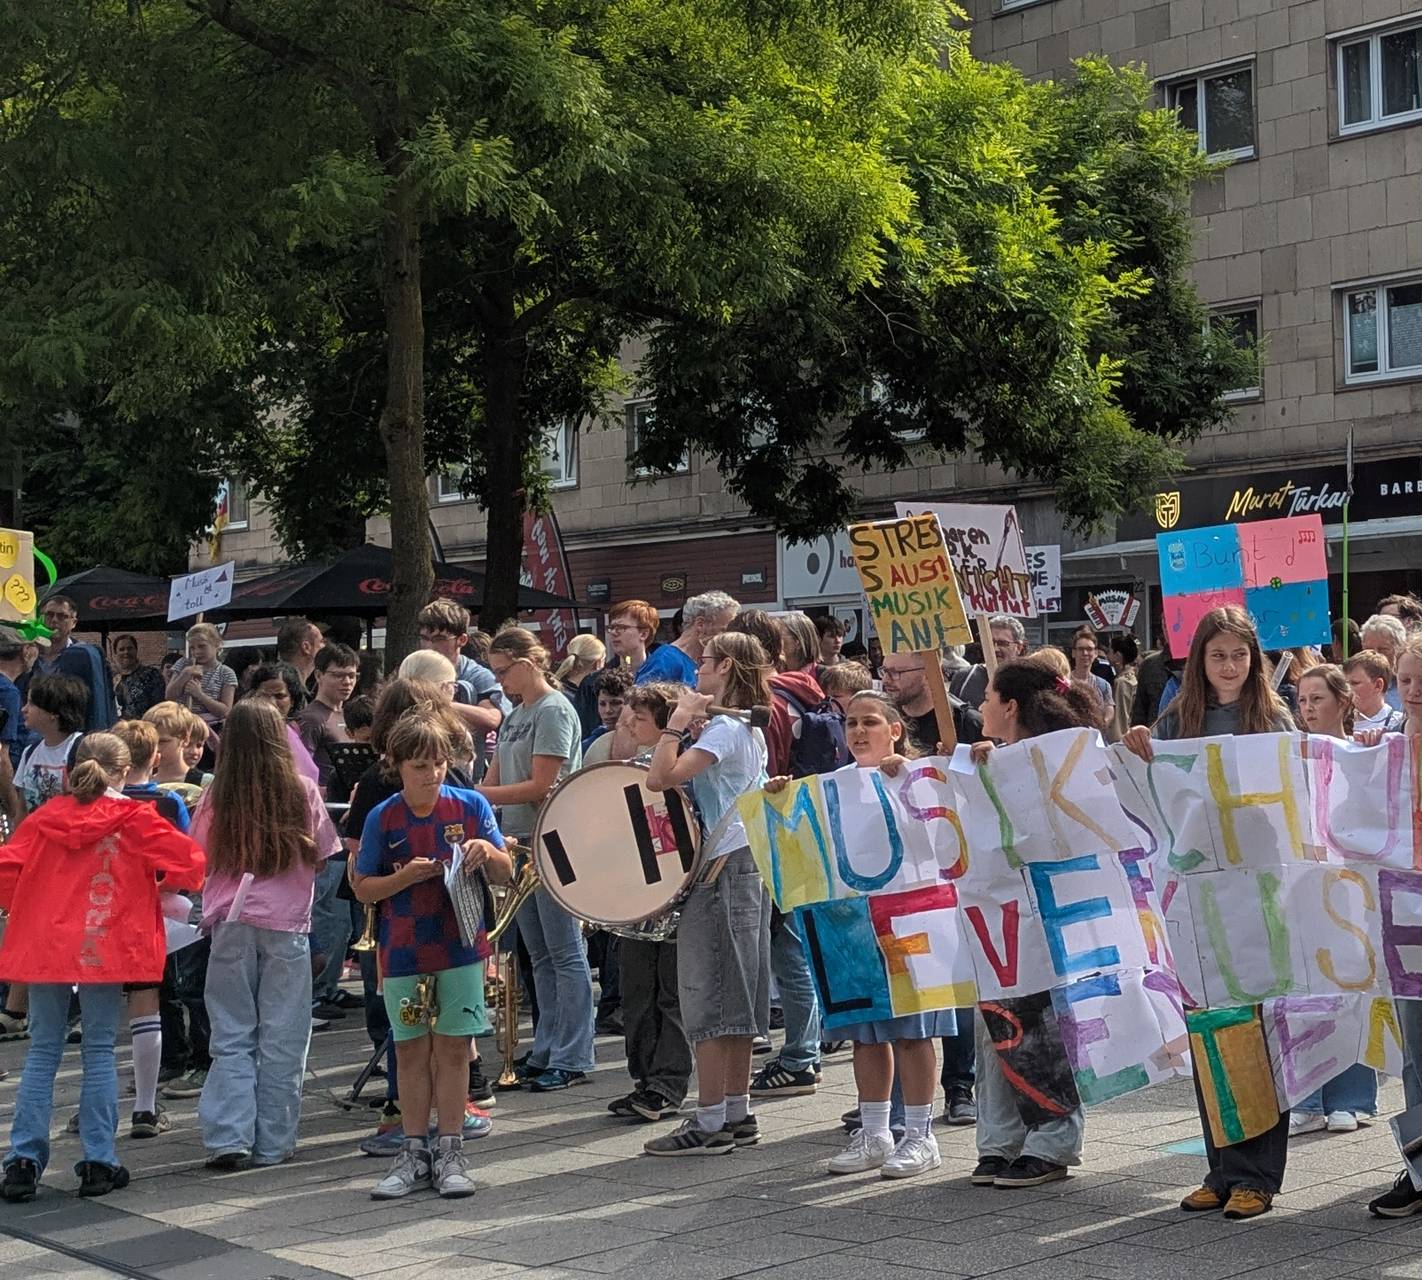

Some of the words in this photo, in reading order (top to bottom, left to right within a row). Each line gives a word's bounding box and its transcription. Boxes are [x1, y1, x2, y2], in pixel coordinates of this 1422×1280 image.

[1225, 480, 1296, 520] Murat
[850, 516, 943, 562] STRES
[1193, 533, 1267, 569] Bunt
[871, 586, 952, 618] MUSIK
